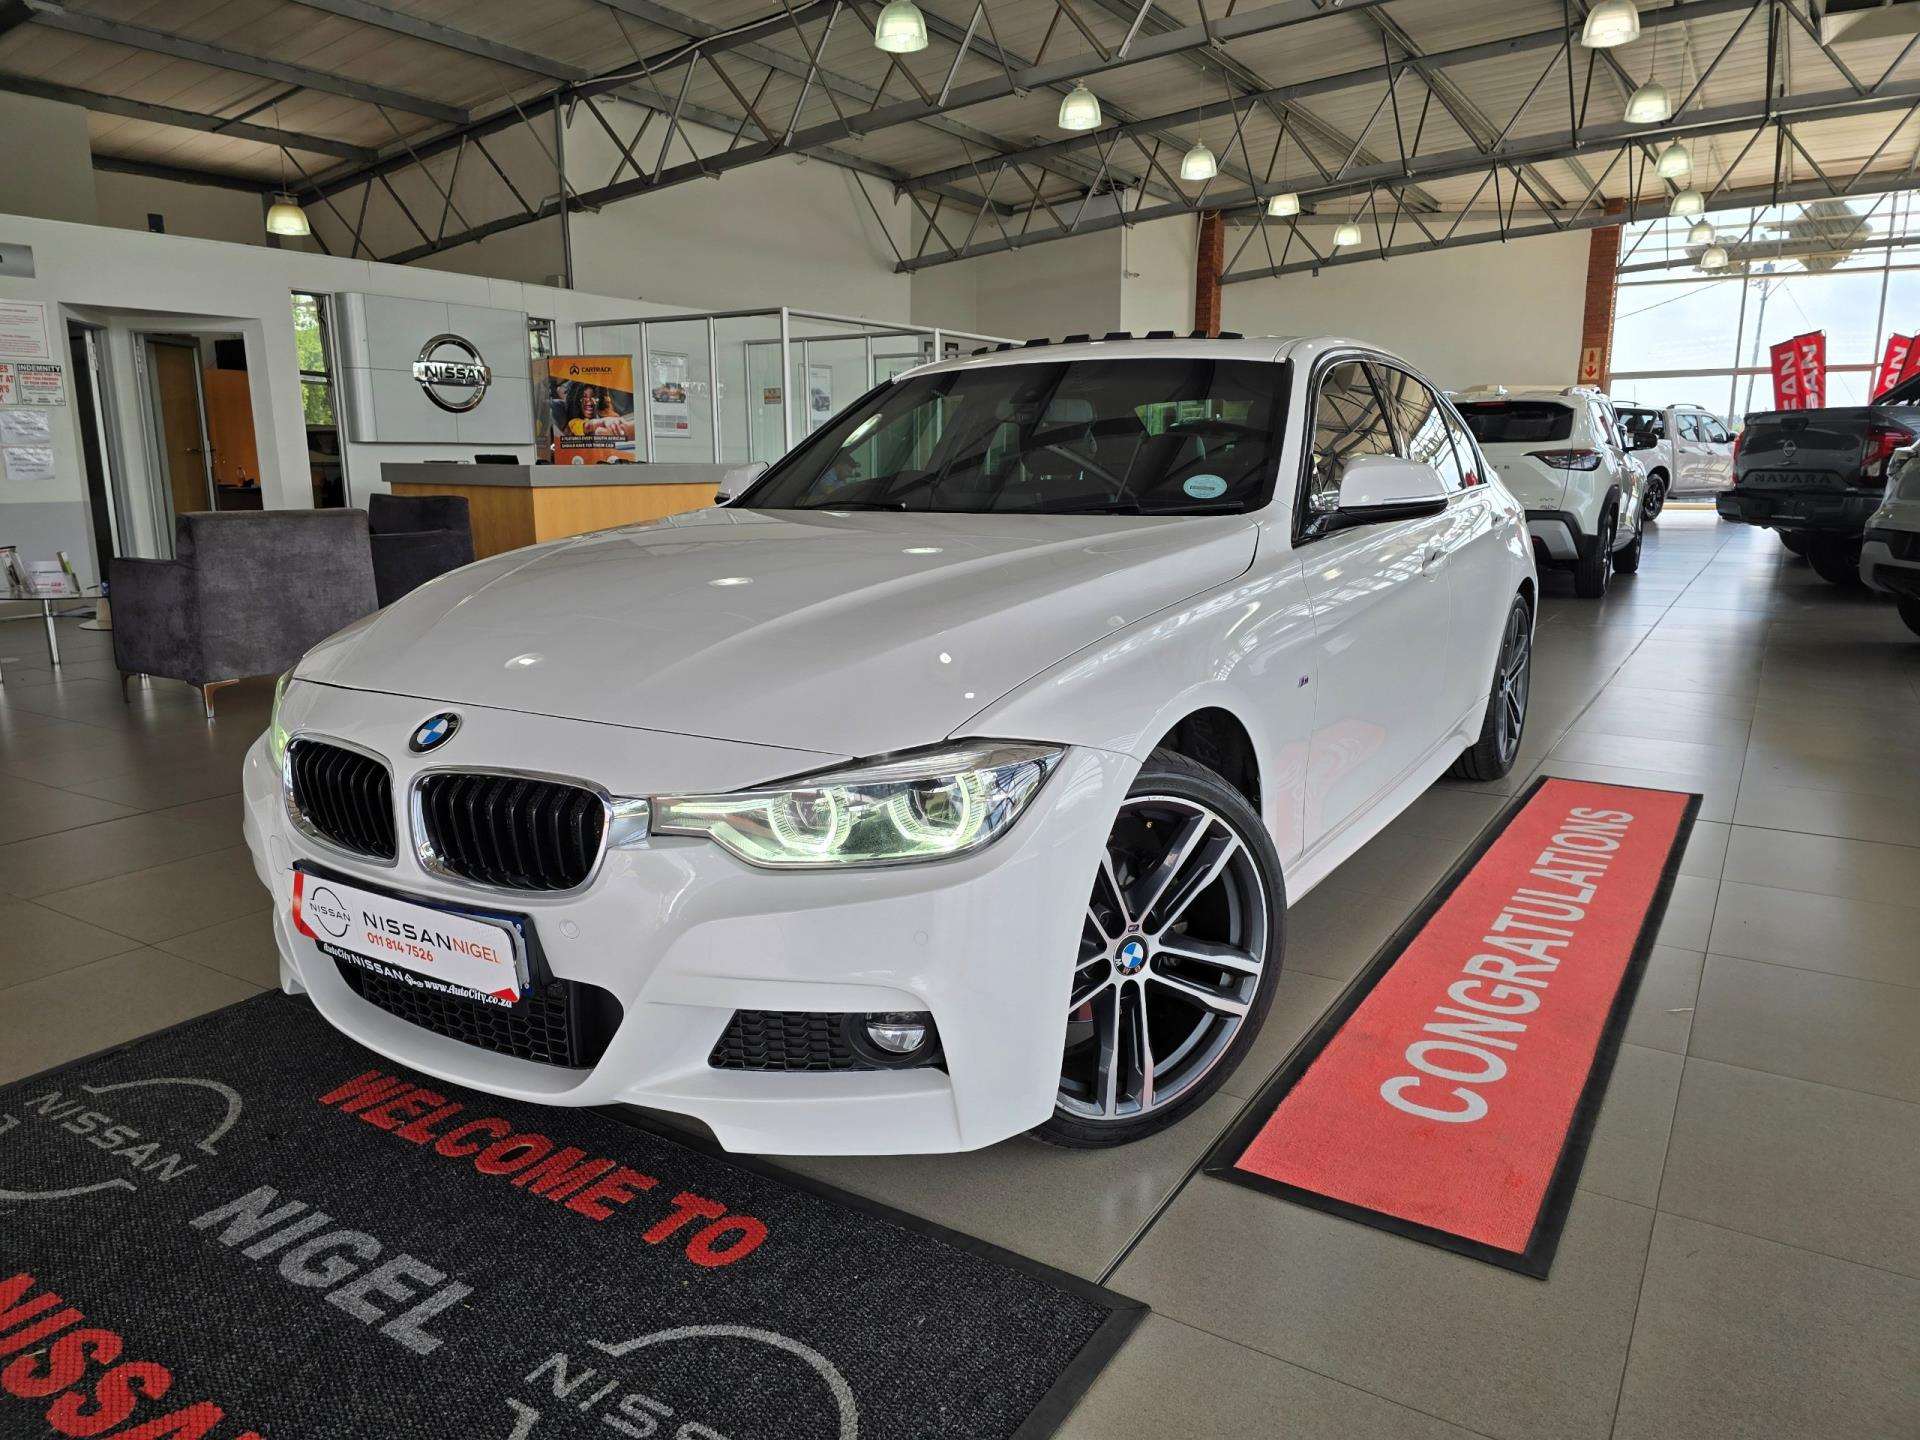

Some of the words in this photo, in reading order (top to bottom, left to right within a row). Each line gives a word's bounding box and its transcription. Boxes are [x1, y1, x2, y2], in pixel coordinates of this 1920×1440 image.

[18, 364, 61, 372] INDEMNITY
[424, 365, 486, 381] NISSAN
[1754, 474, 1832, 484] NAVARA
[309, 902, 351, 922] NISSAN
[367, 932, 384, 946] 011
[386, 938, 404, 953] 814
[405, 944, 434, 962] 7526
[1380, 807, 1634, 1123] CONGRATULATIONS
[323, 943, 352, 964] AutoCity
[351, 954, 404, 981] NISSAN
[424, 980, 513, 1008] www.AutoCity.co.za
[24, 1091, 198, 1182] NISSAN
[319, 1068, 656, 1221] WELCOME
[642, 1191, 769, 1268] TO
[188, 1184, 475, 1356] NIGEL
